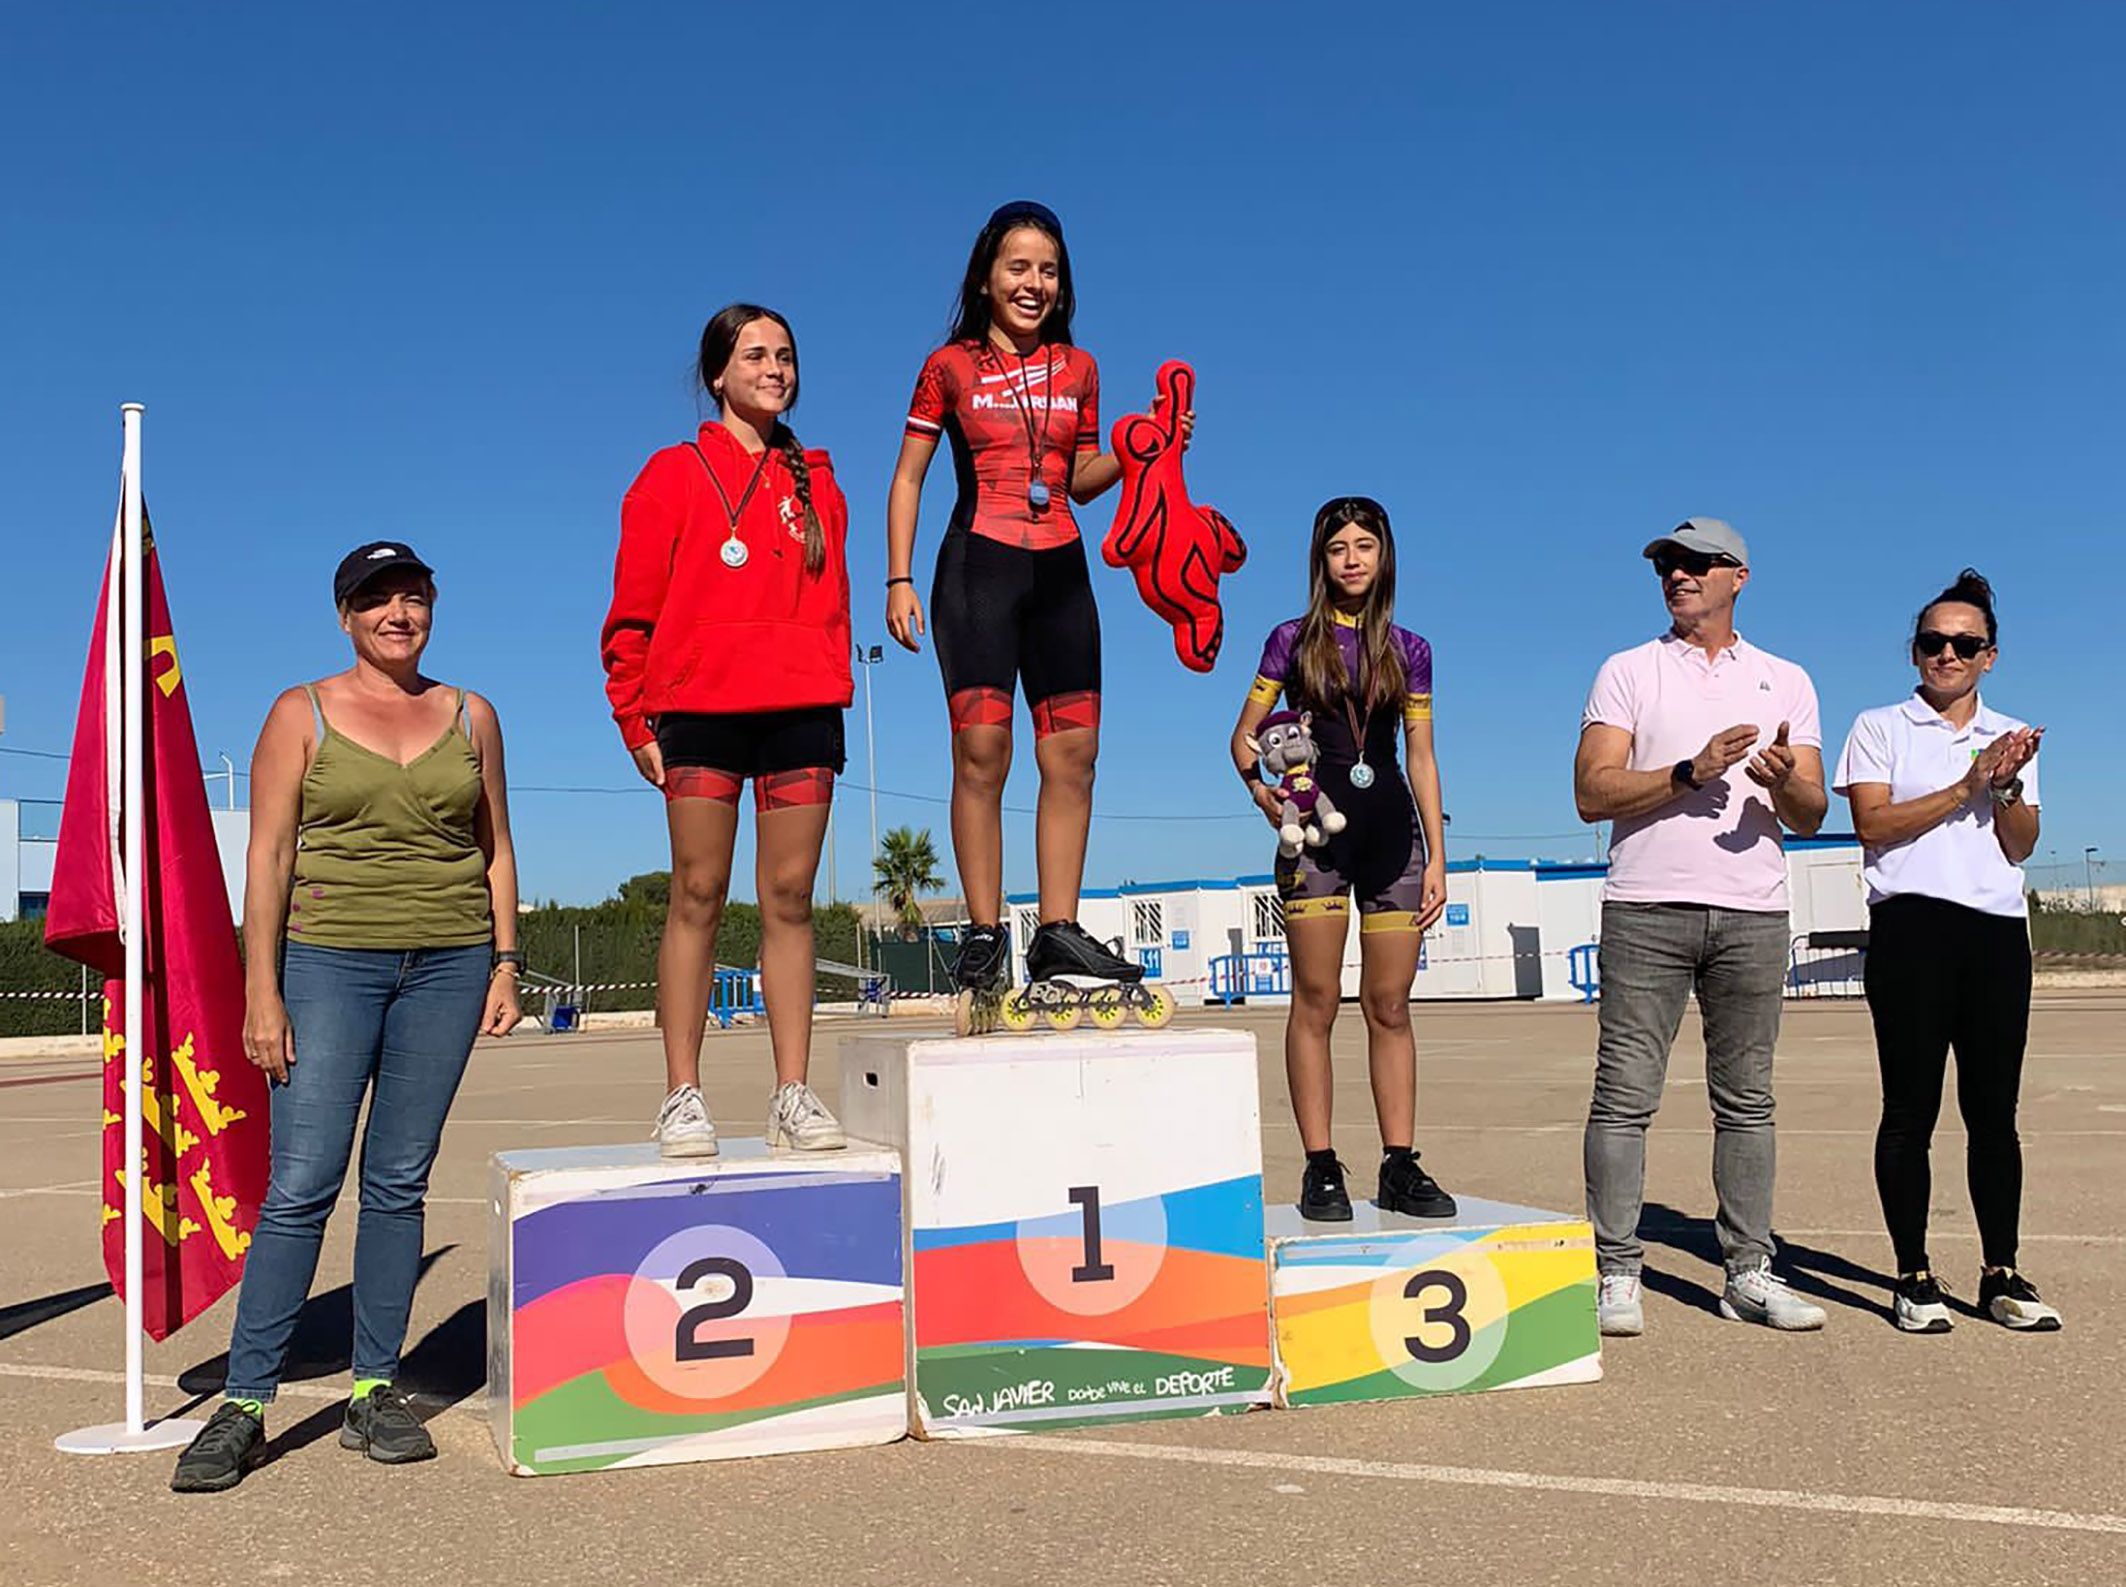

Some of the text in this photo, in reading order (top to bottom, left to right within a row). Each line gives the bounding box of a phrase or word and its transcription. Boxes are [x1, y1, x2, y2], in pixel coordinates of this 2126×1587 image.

[1068, 1186, 1114, 1282] 1
[676, 1257, 754, 1362] 2
[1403, 1270, 1471, 1363] 3
[943, 1393, 984, 1419] SAN
[986, 1380, 1055, 1415] JAVIER
[1155, 1366, 1236, 1396] DEPORTE
